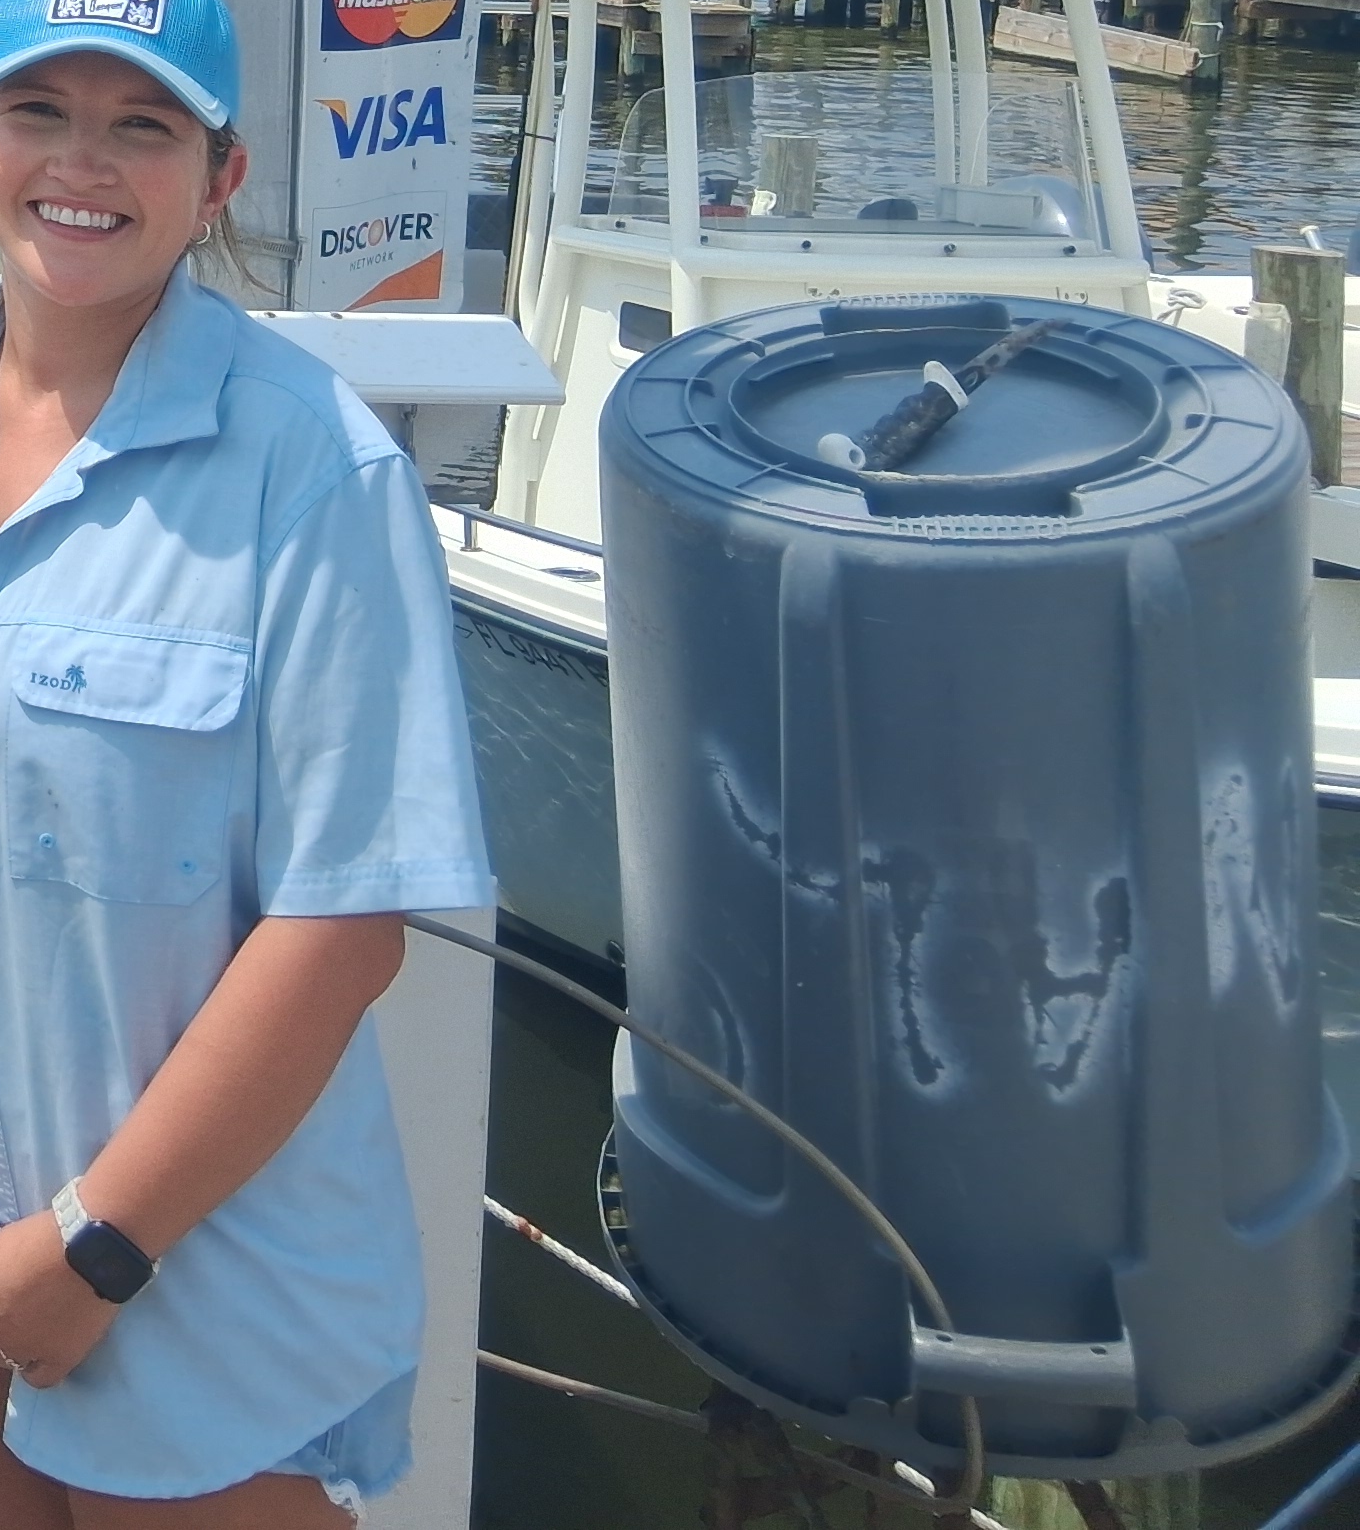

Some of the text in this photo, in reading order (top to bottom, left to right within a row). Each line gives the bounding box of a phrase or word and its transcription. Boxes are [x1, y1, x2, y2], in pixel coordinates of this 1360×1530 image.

[313, 86, 447, 159] VISA
[320, 212, 433, 258] DISCOVER
[349, 251, 393, 271] NETWORK
[30, 672, 71, 690] IZOD
